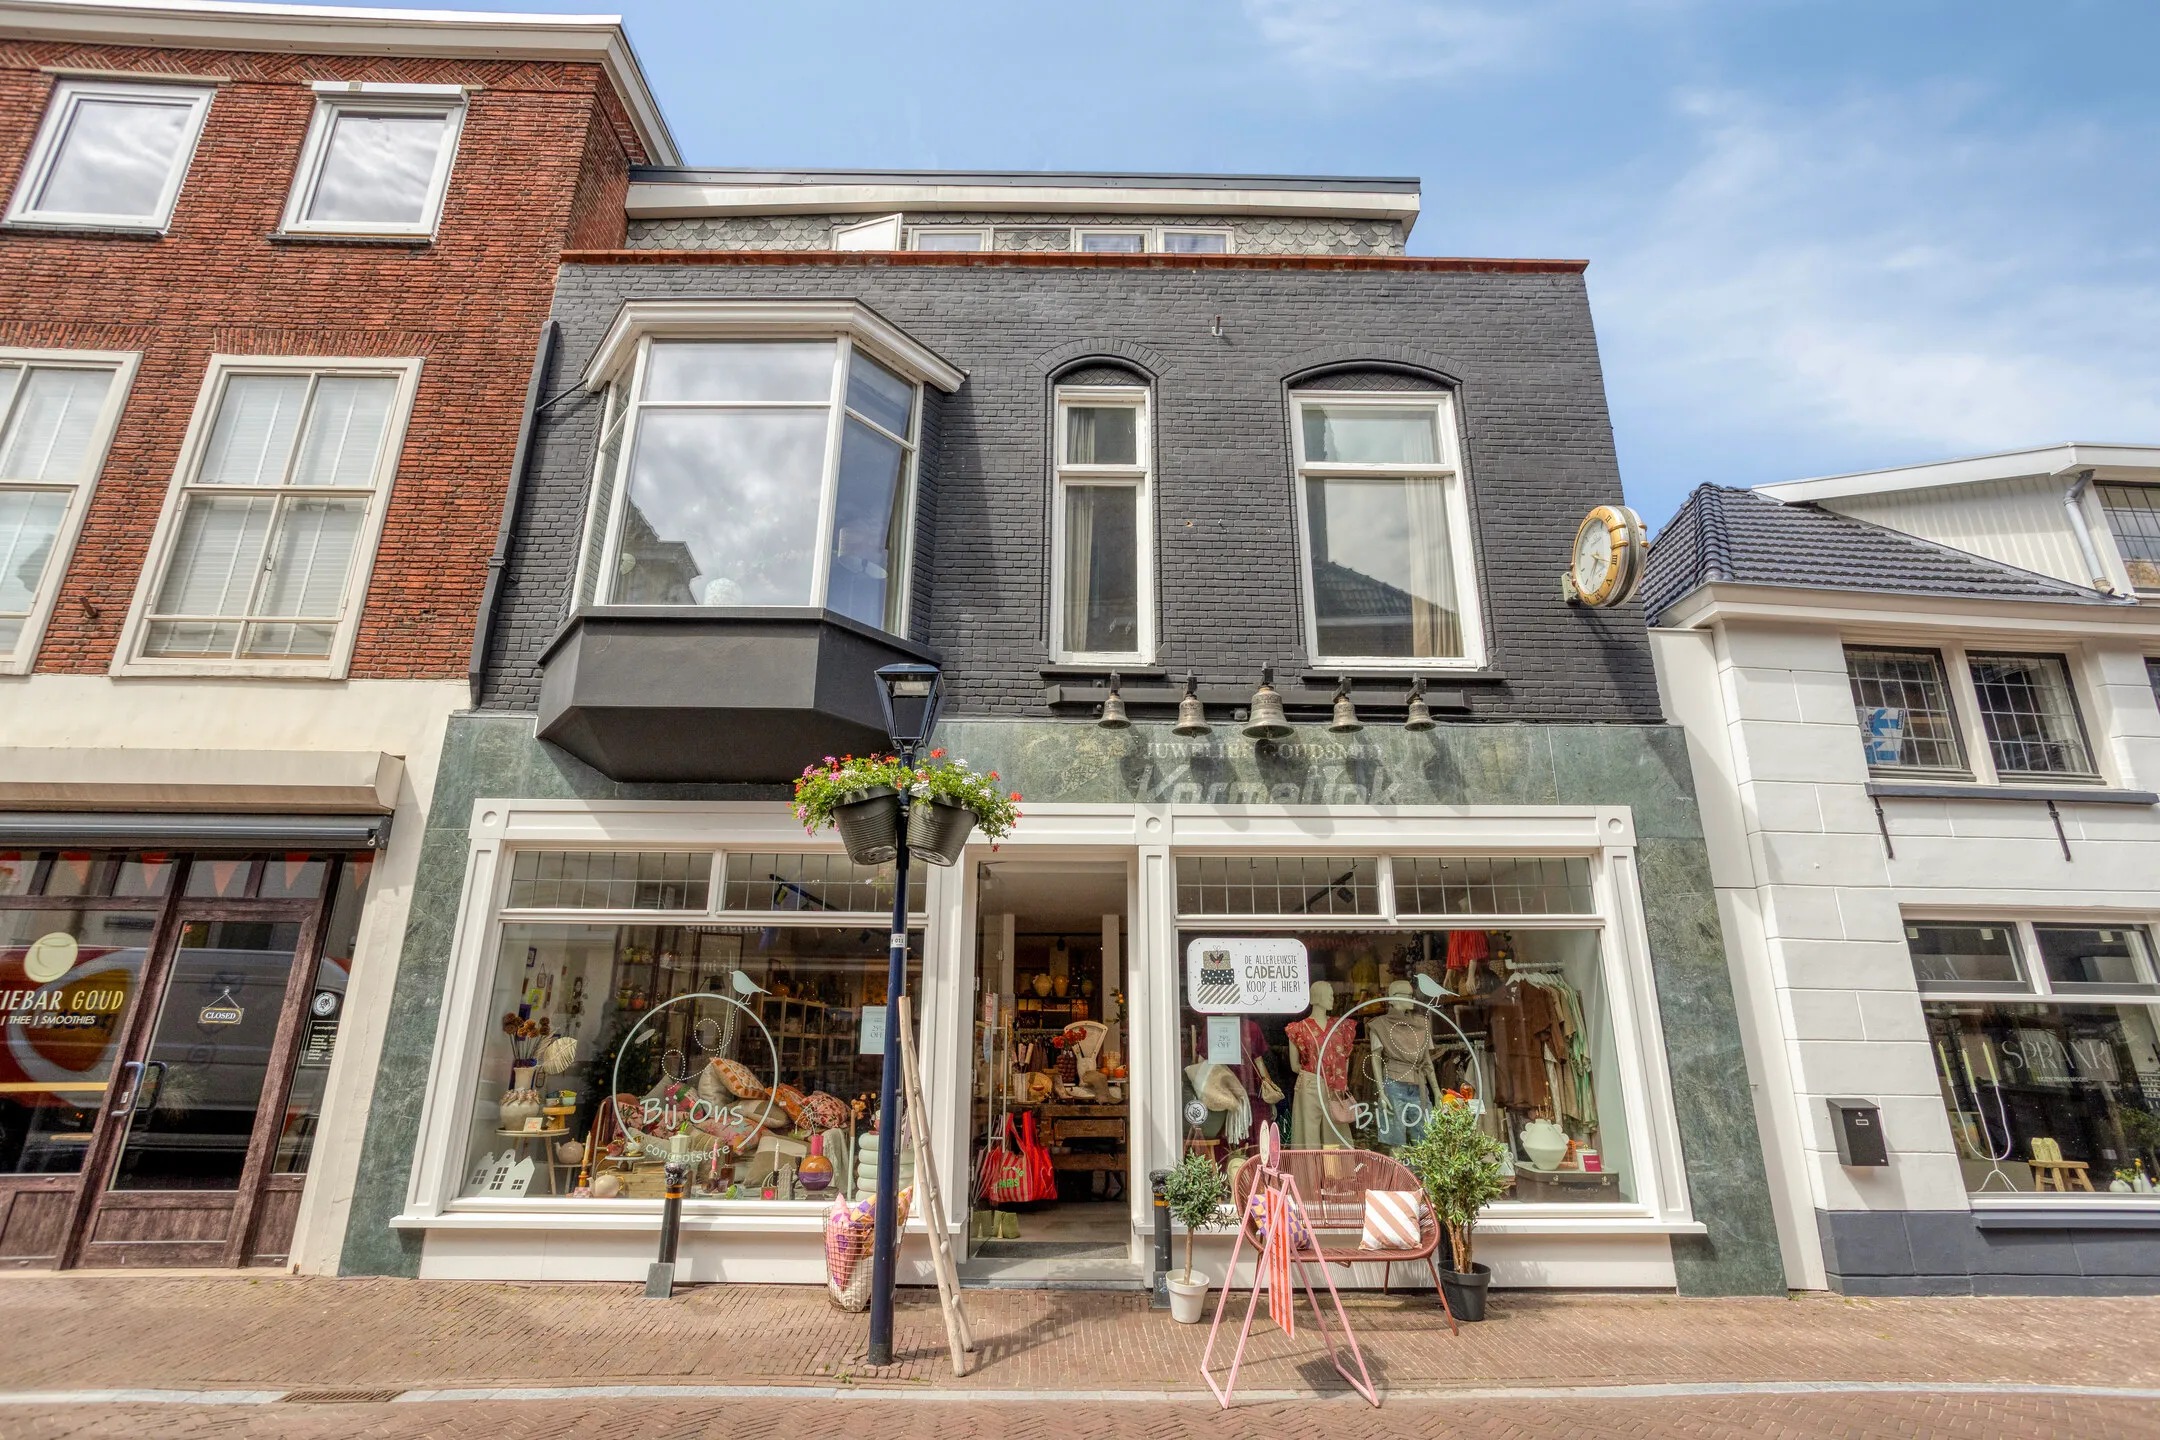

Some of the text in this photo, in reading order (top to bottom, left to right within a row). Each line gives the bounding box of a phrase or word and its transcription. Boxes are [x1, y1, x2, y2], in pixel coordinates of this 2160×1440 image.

[1245, 955, 1297, 965] DE ALLERLEUKSTE
[1245, 965, 1299, 979] CADEAUS
[1246, 980, 1301, 993] KOOP JE HIER!
[0, 990, 124, 1010] IEBAR GOUD
[9, 1015, 31, 1025] THEE
[41, 1015, 96, 1025] SMOOTHIES
[205, 1011, 236, 1019] CLOSED
[640, 1095, 744, 1131] Bij Ons
[1349, 1101, 1390, 1134] Bij
